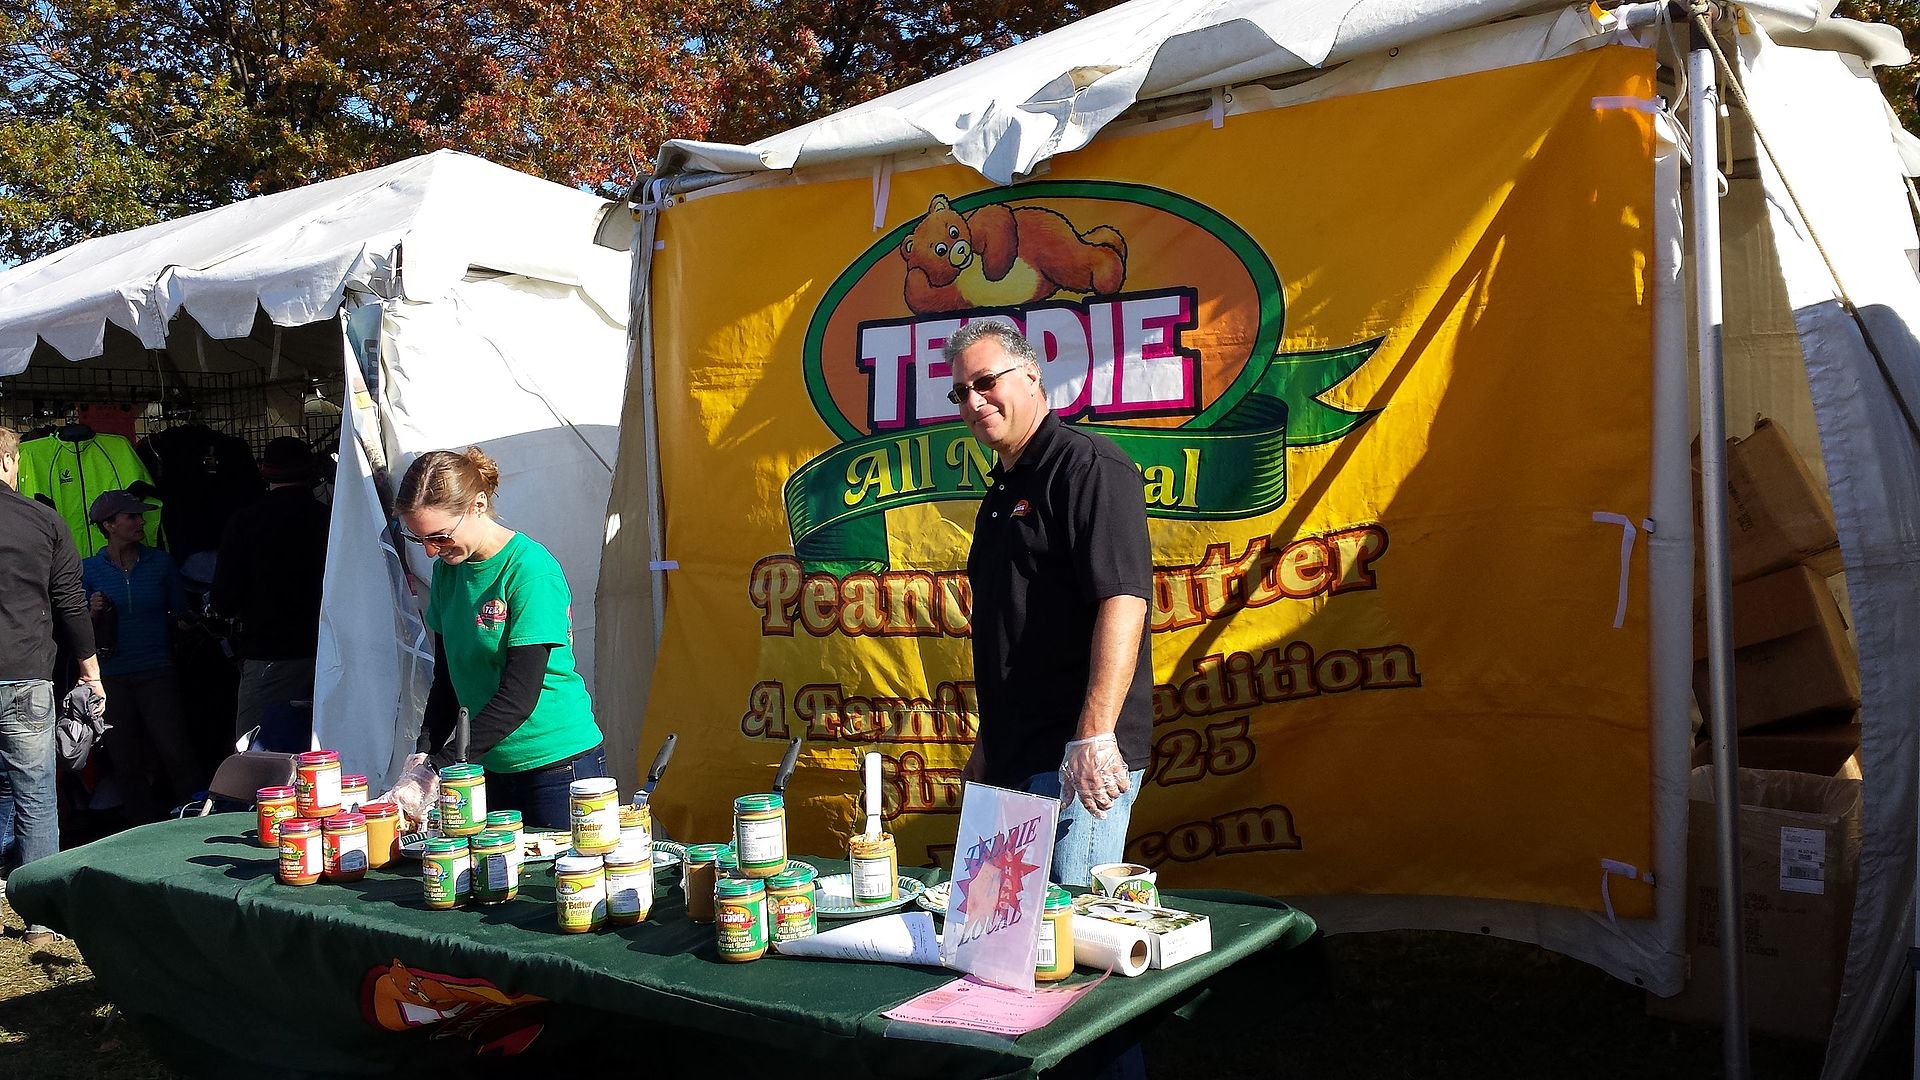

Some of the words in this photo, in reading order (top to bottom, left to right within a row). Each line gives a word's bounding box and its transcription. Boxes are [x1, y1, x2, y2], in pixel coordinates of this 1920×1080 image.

[844, 434, 936, 506] All
[748, 554, 972, 638] Peanu
[1150, 523, 1390, 633] utter
[742, 681, 790, 739] A
[795, 681, 979, 744] Famil
[1152, 641, 1423, 721] adition
[858, 751, 963, 822] Sin
[1146, 715, 1256, 787] 25
[720, 913, 746, 923] TEDDIE
